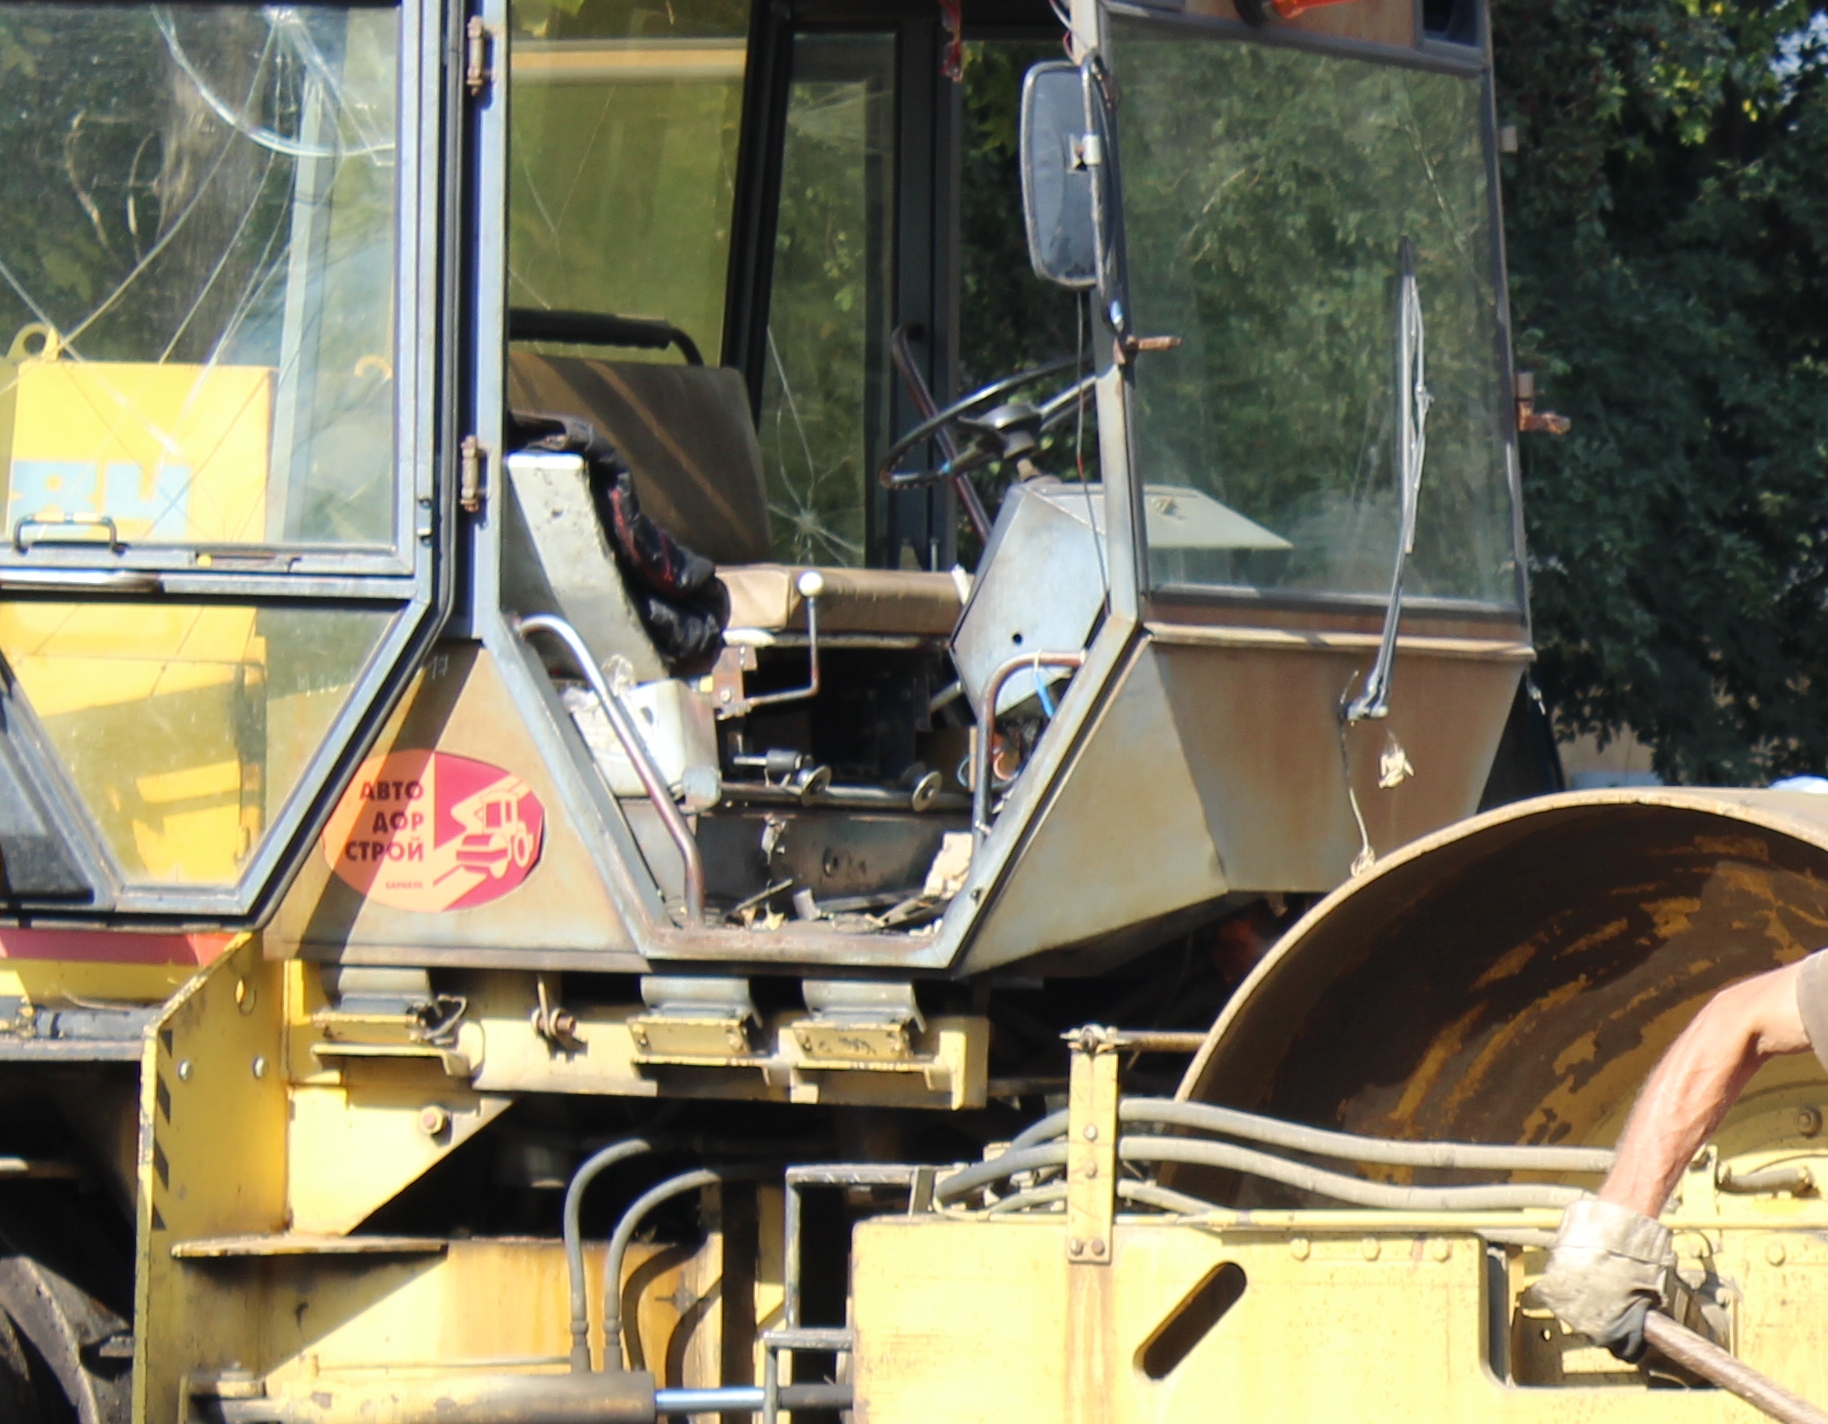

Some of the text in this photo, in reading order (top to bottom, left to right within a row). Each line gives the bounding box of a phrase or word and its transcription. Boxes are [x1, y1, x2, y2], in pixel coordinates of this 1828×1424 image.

[360, 780, 424, 801] АВТО
[372, 812, 424, 834] ДОР
[345, 836, 424, 862] СТРОЙ
